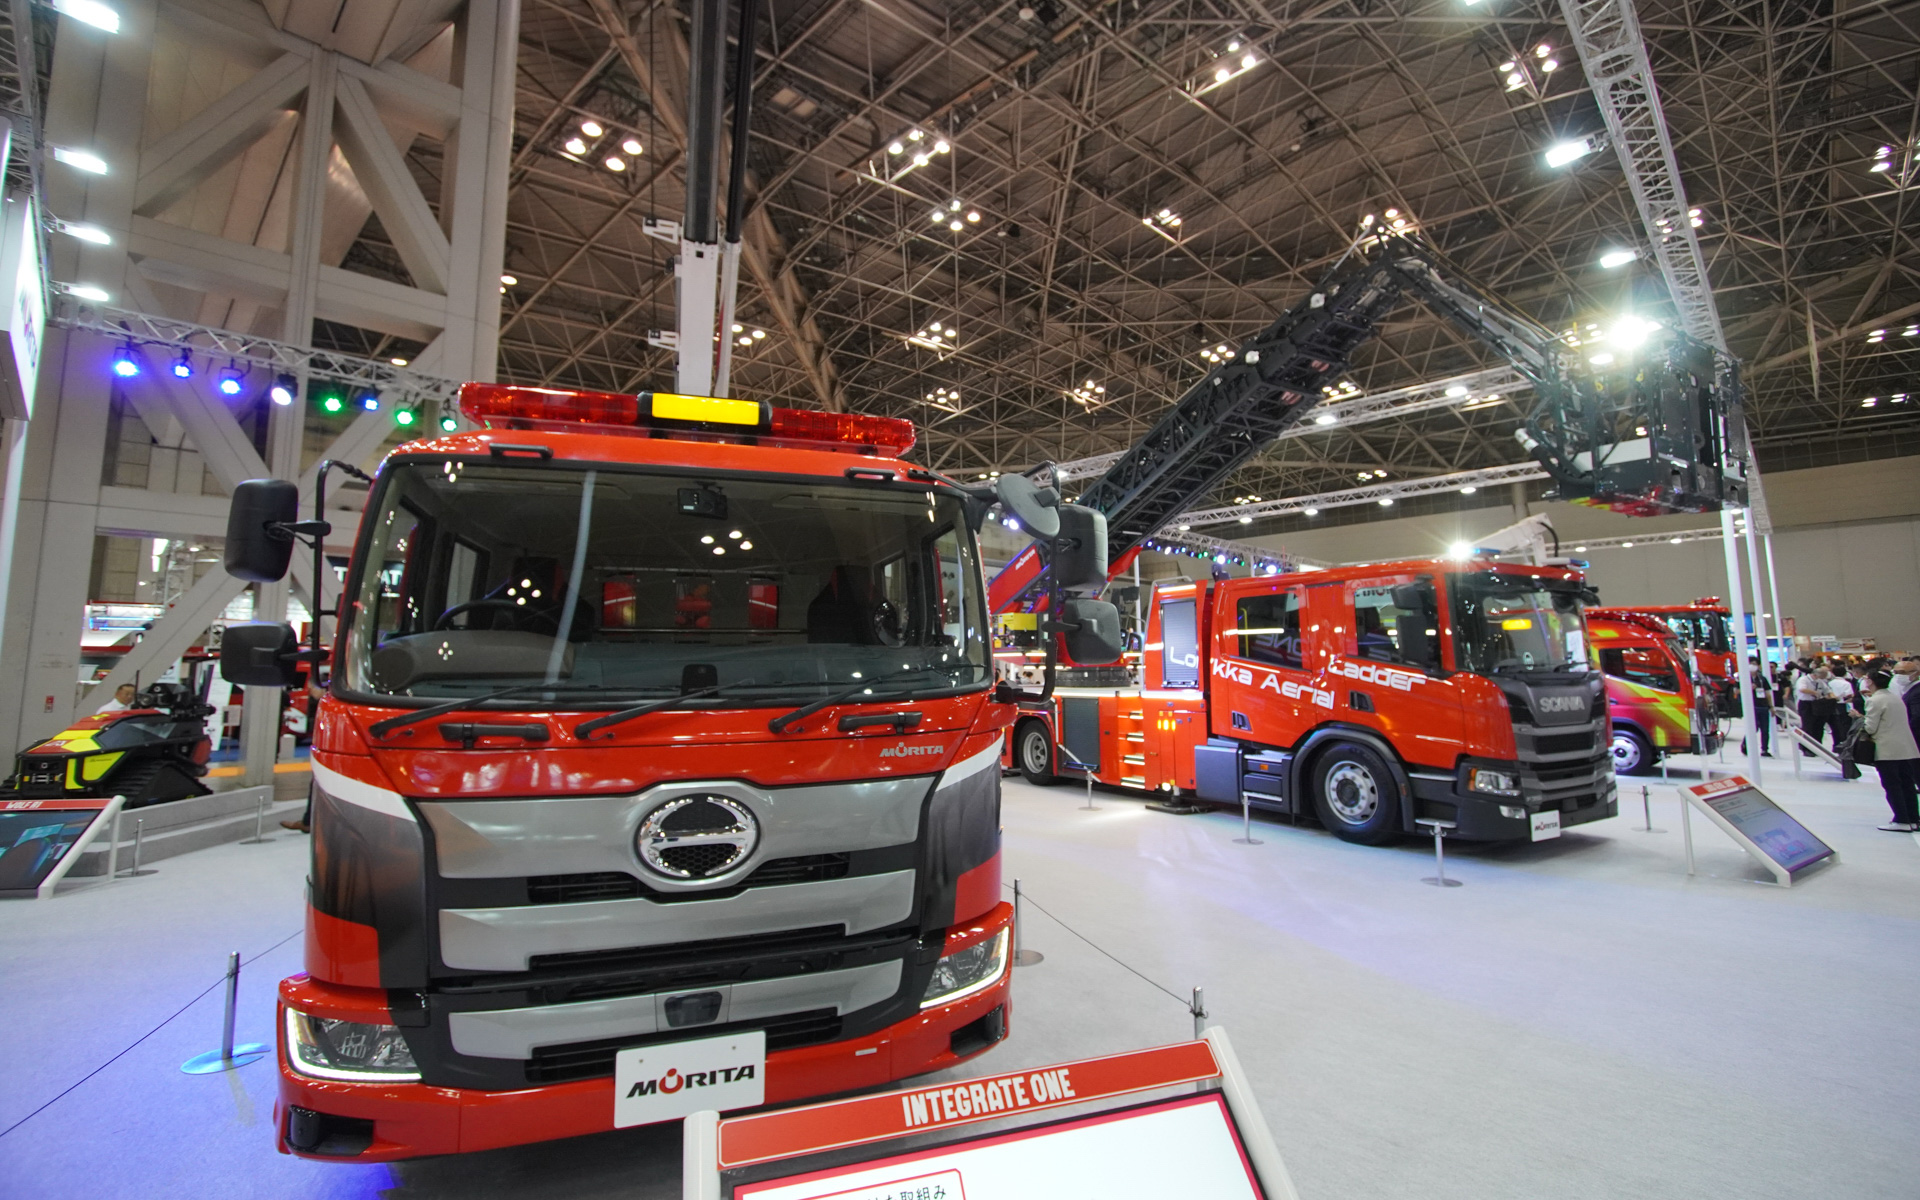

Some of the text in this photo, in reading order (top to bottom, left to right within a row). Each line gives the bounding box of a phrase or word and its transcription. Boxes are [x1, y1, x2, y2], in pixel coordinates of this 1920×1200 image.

[1260, 673, 1335, 710] Aerial
[1327, 654, 1427, 692] Ladder
[1540, 696, 1585, 712] SCANIA
[879, 741, 944, 758] MORITA
[626, 1064, 755, 1099] MORITA
[902, 1068, 1076, 1127] INTEGRATE ONE
